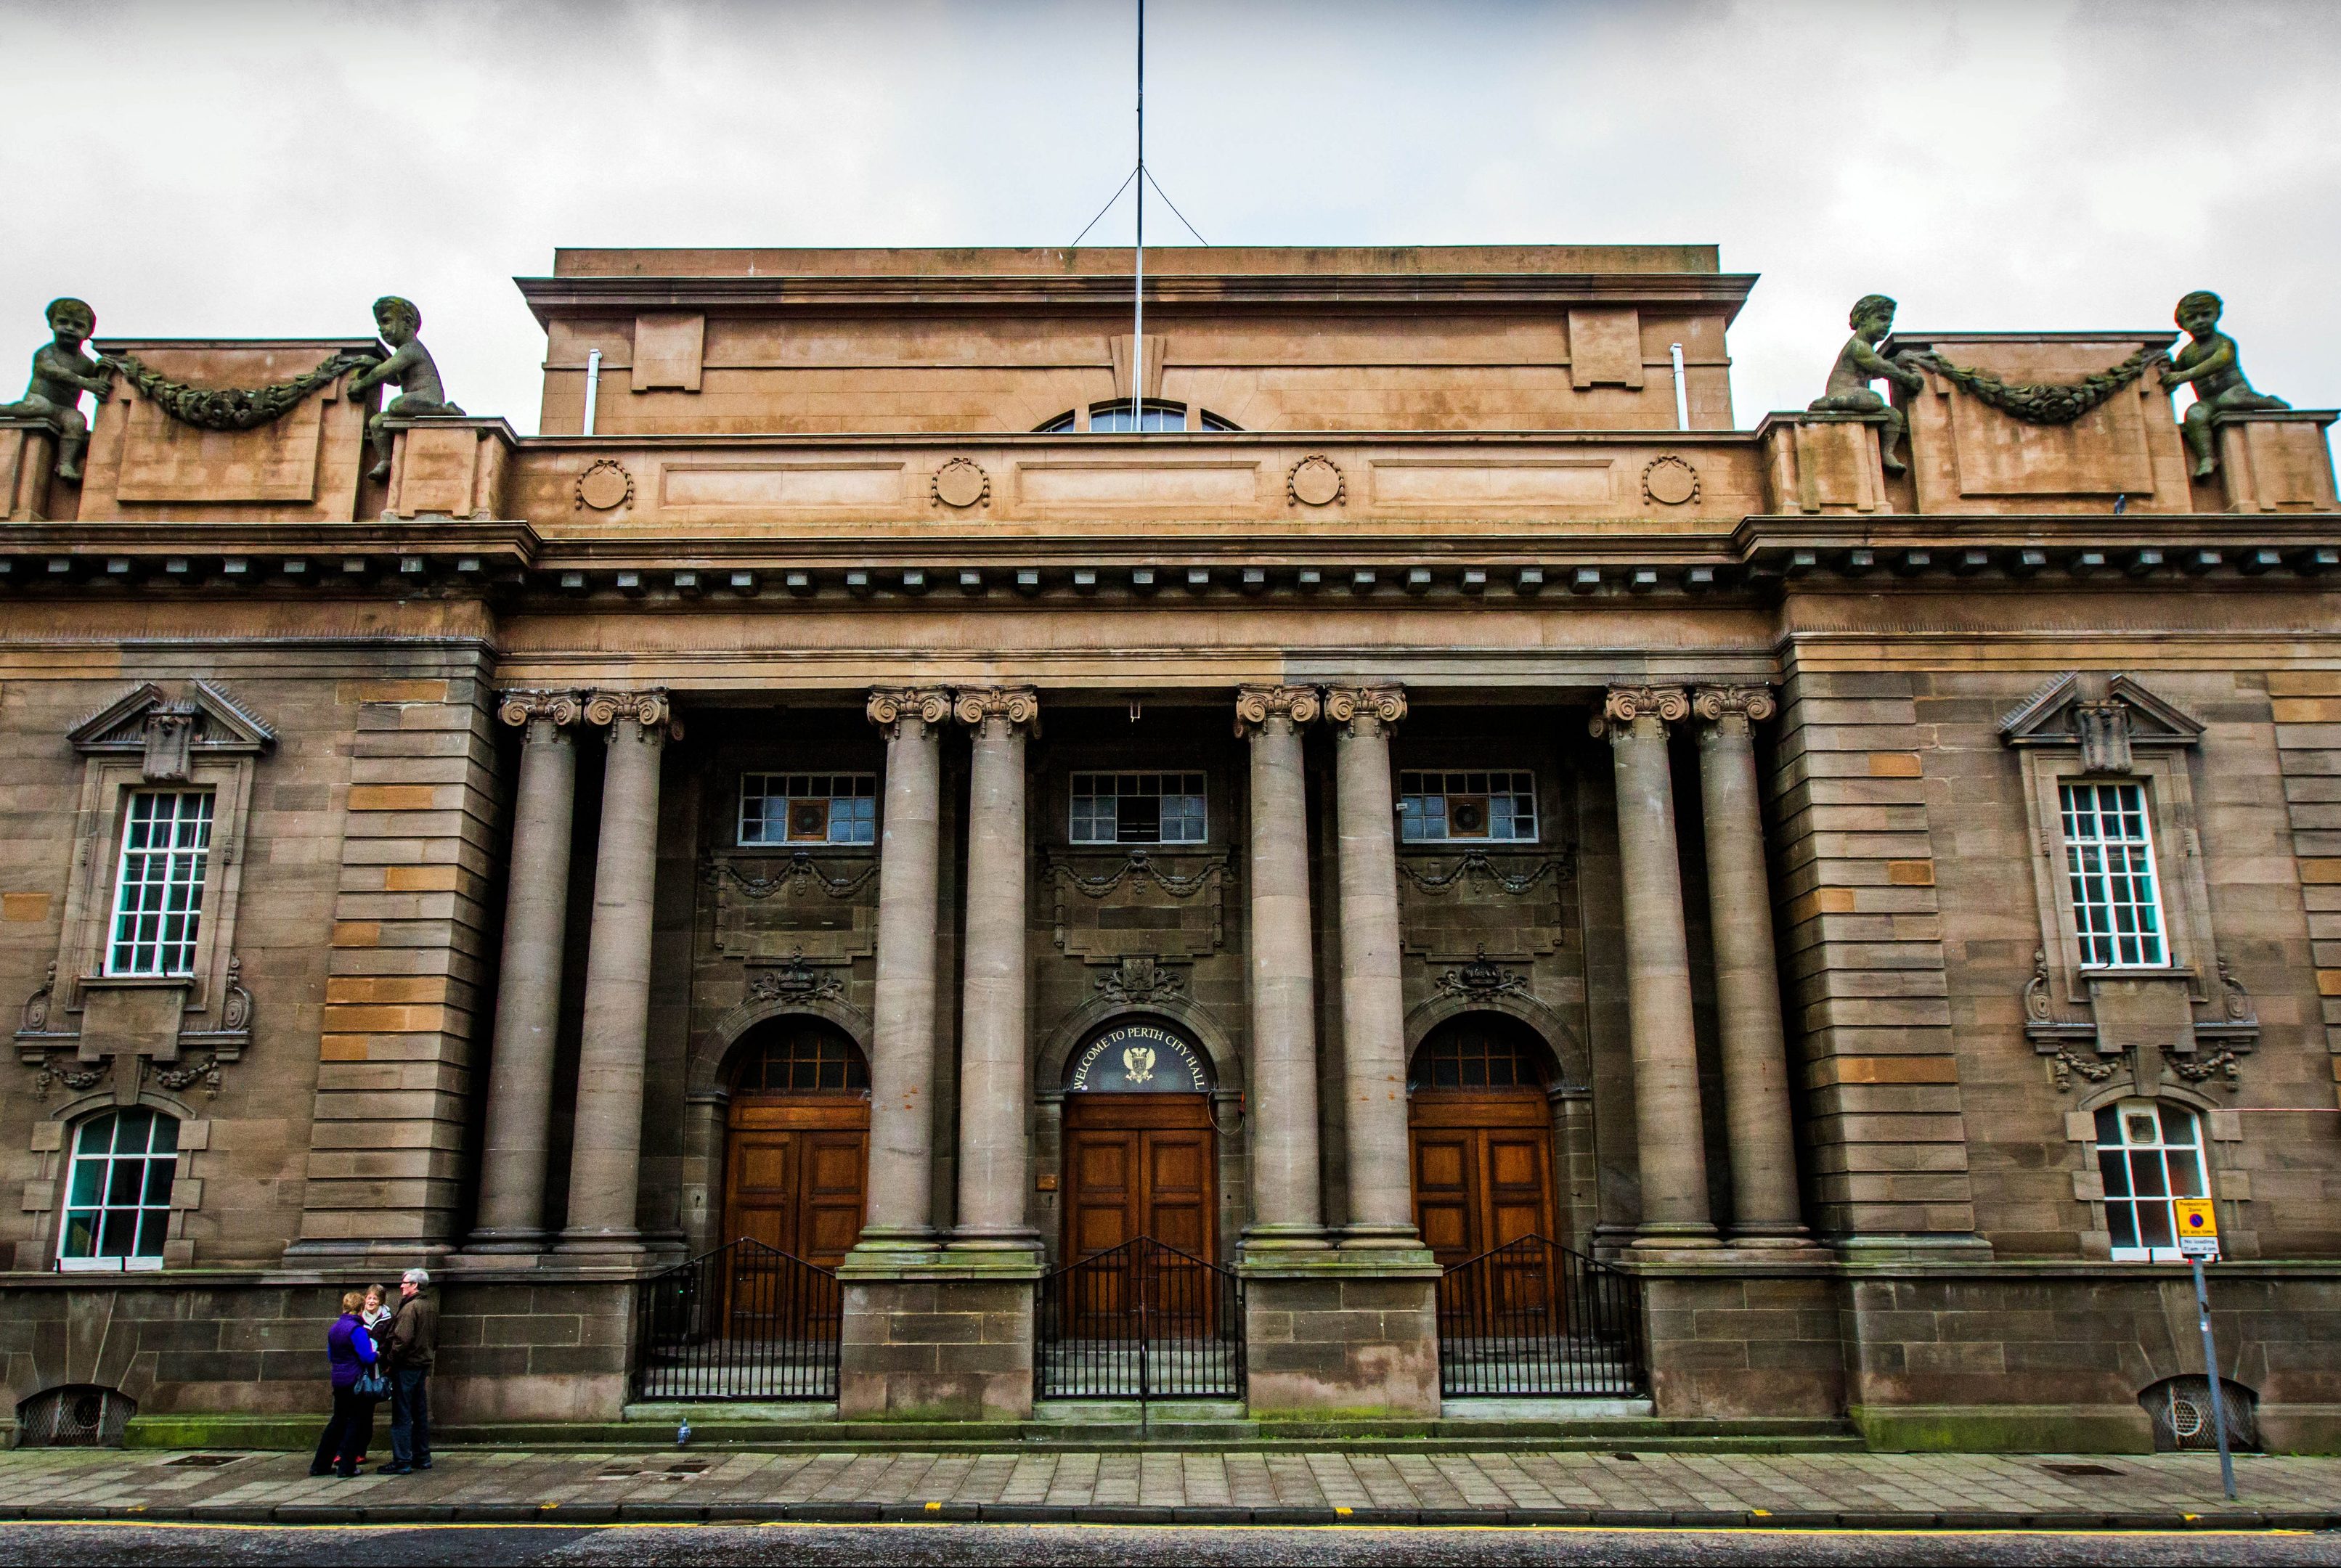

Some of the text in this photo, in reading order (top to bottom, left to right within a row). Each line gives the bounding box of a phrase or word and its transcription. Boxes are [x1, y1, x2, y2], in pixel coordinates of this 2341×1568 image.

[1074, 1027, 1205, 1090] WELCOME TO PERTH CITY HALL
